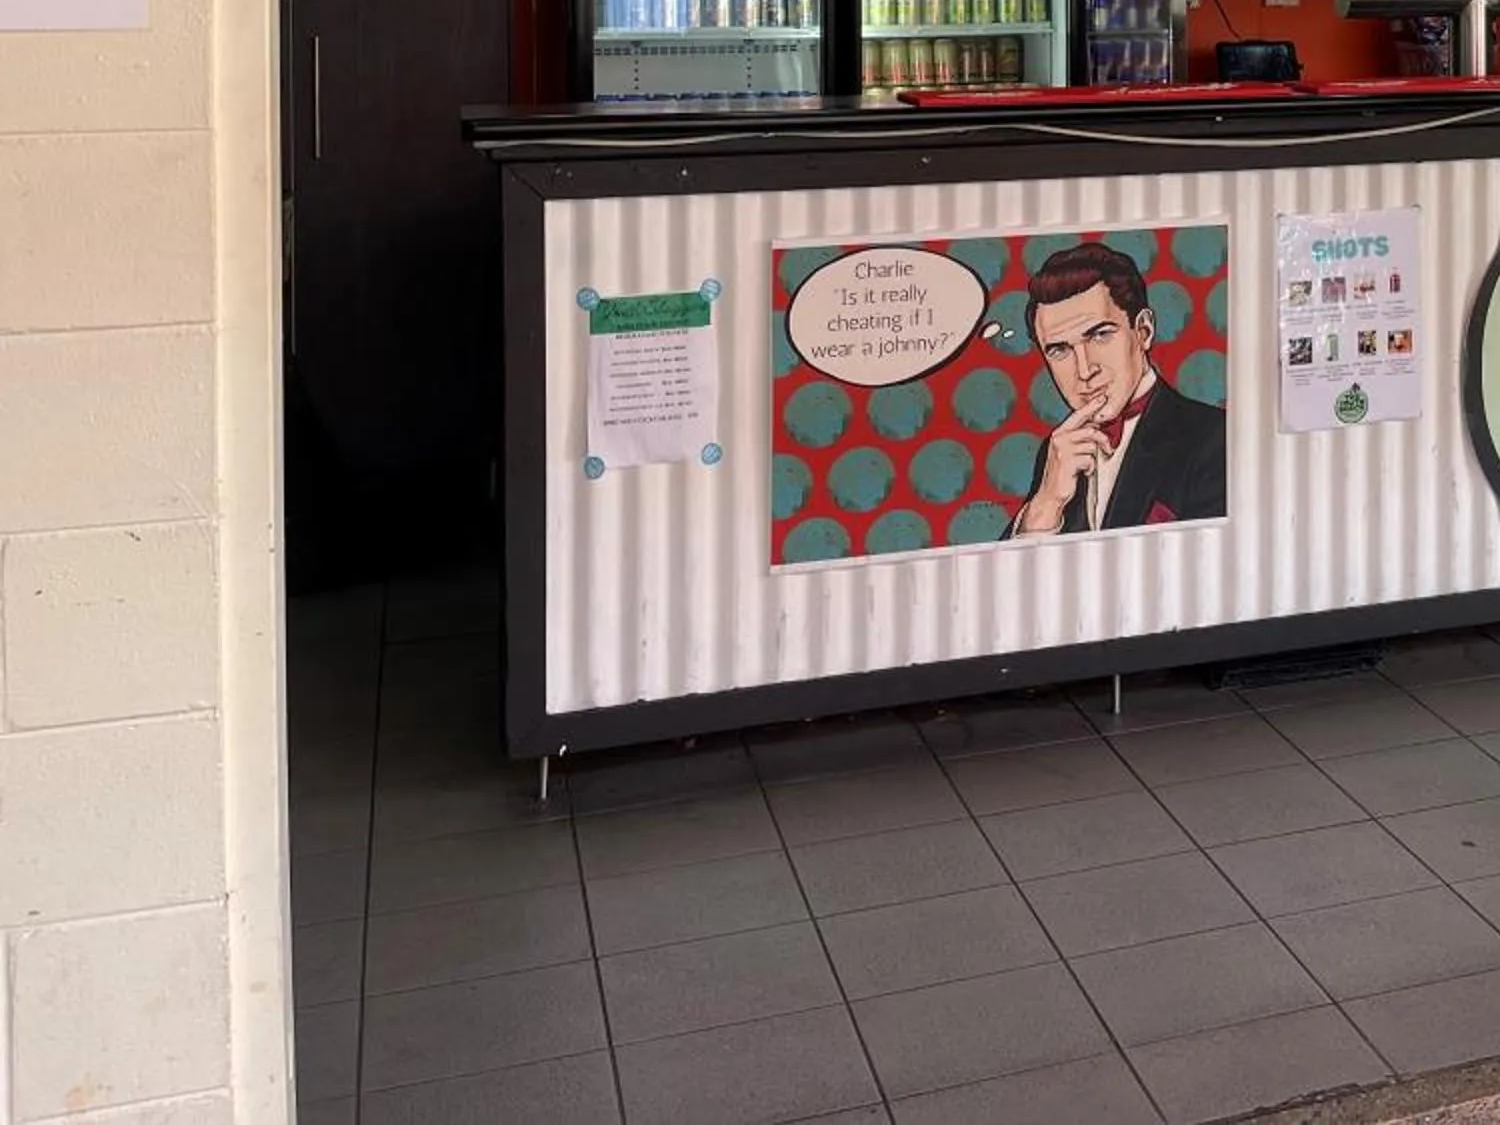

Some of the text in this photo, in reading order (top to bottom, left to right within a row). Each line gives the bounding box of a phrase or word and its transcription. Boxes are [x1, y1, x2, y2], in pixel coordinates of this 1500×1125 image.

[1311, 235, 1390, 263] SHOTS
[854, 259, 915, 280] Charlie
[864, 286, 876, 305] it
[881, 283, 927, 306] really
[827, 308, 934, 333] cheating if I
[811, 342, 855, 360] wear
[861, 341, 873, 356] a
